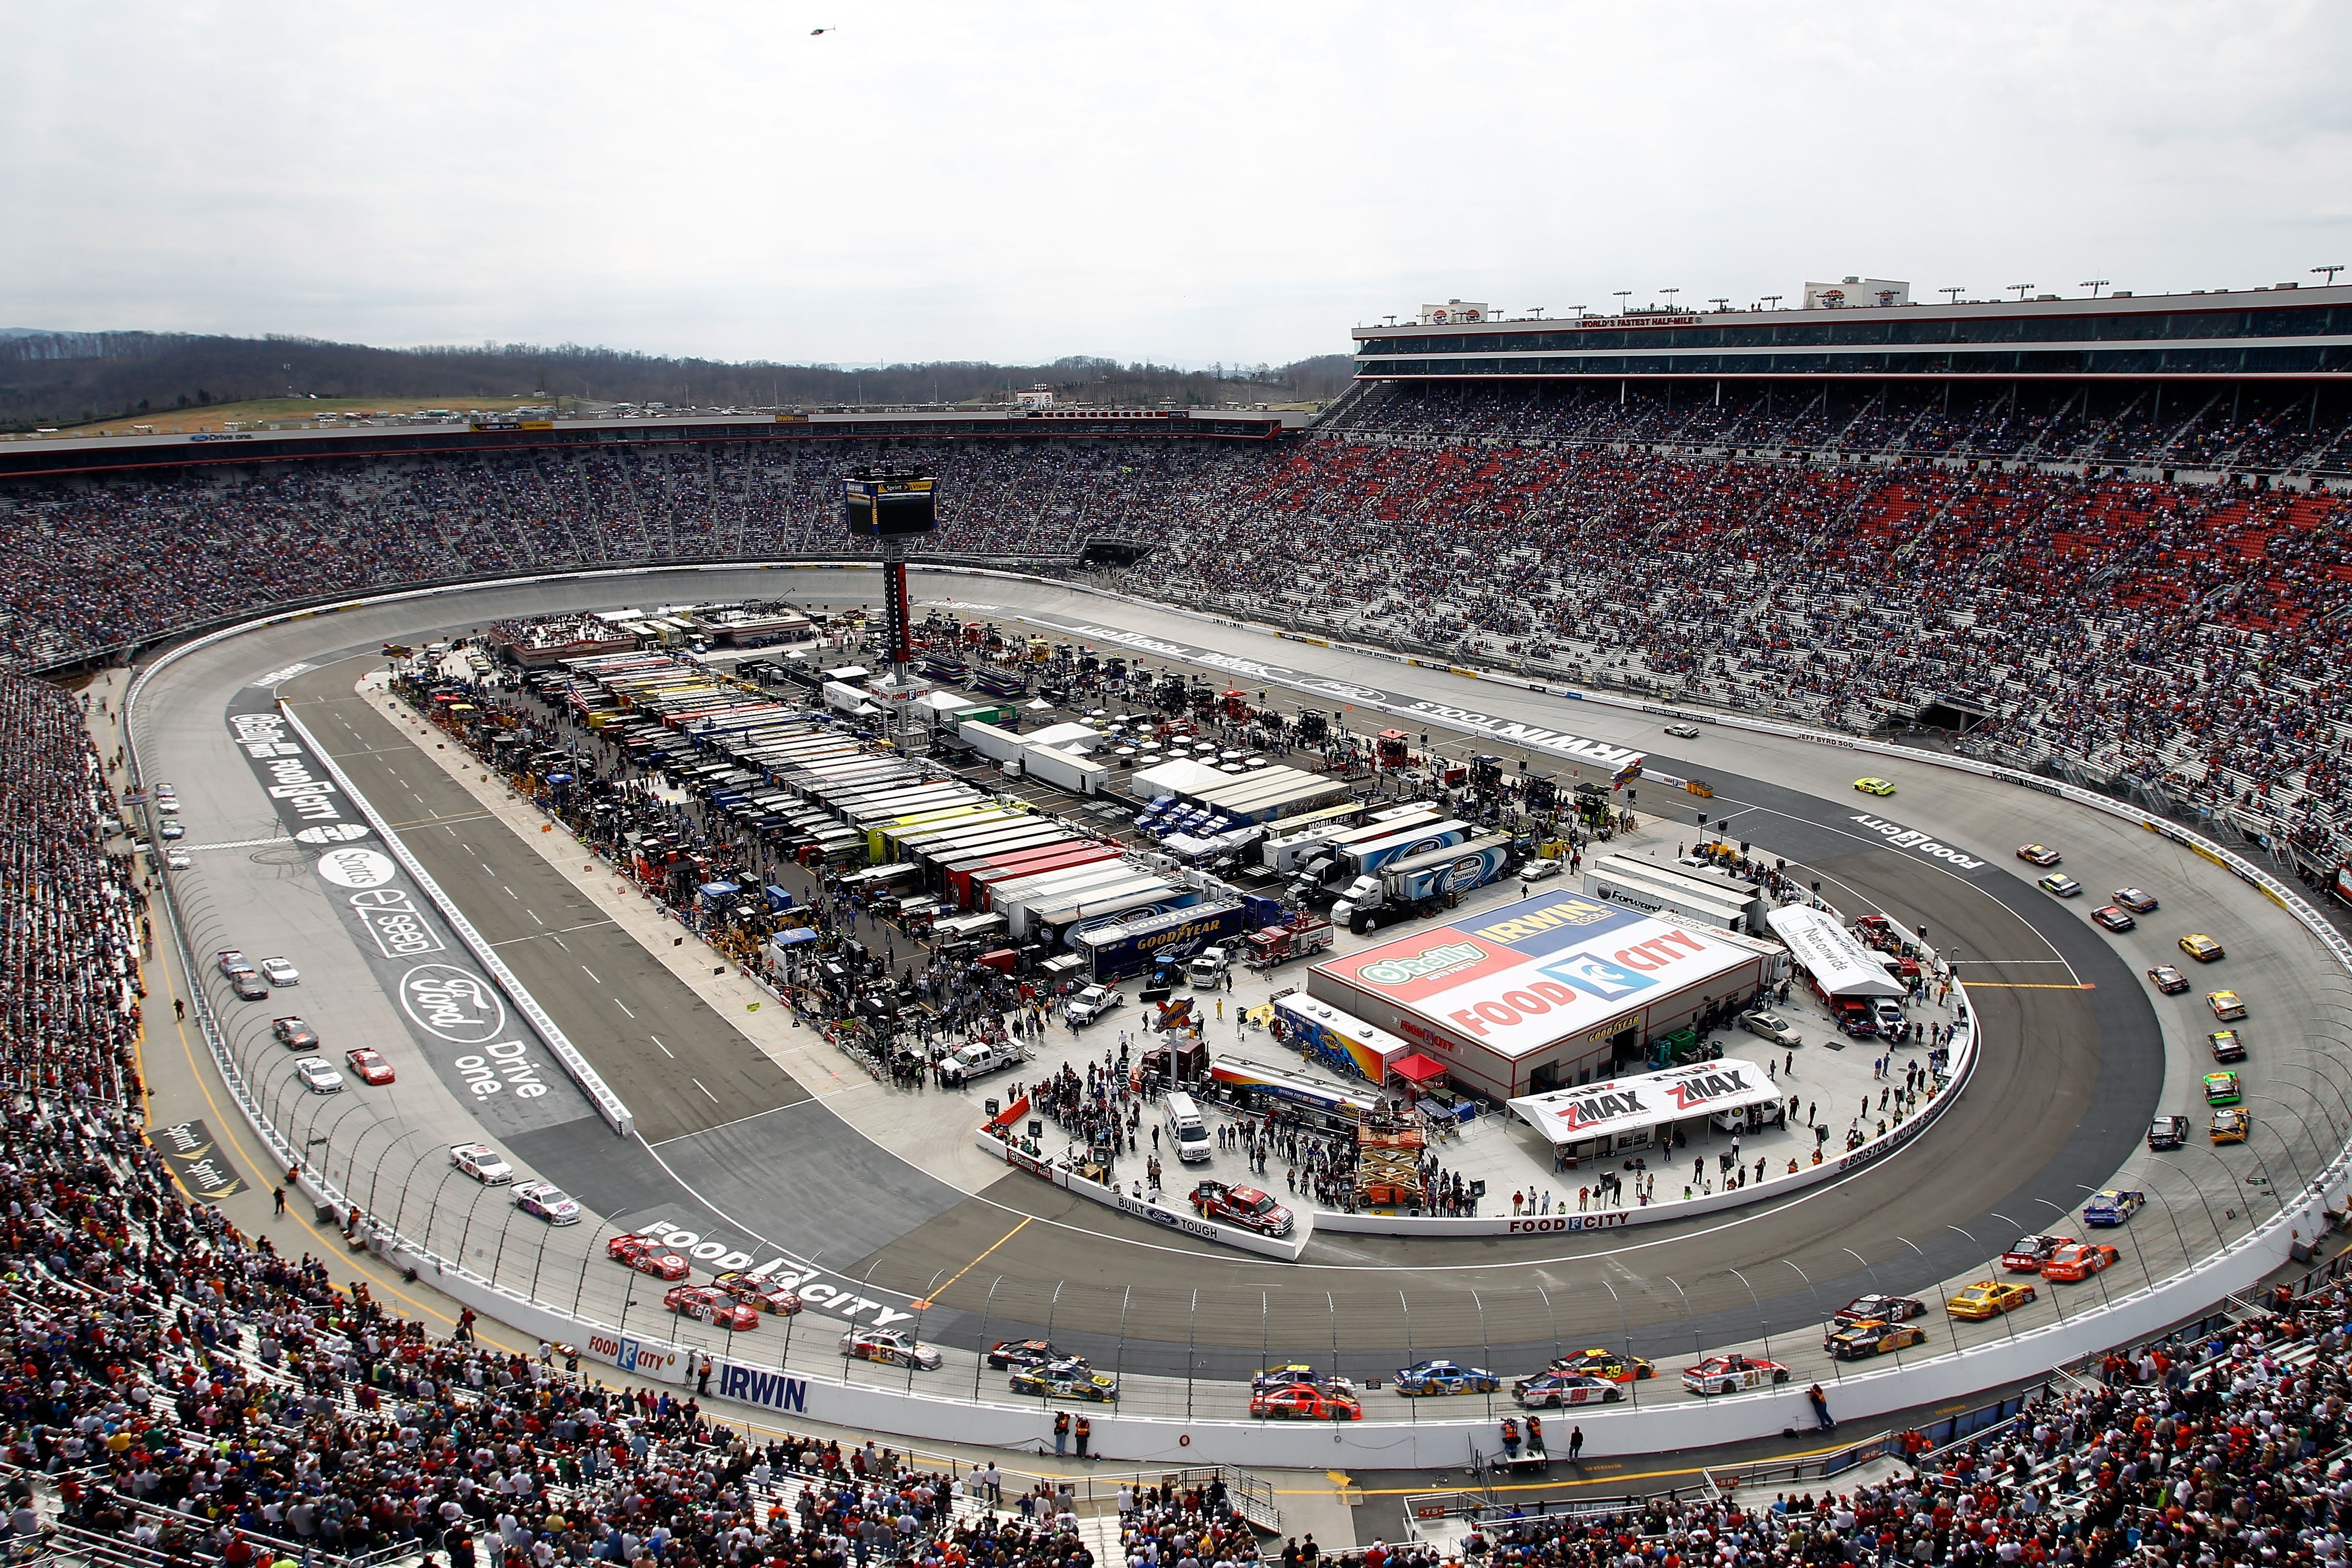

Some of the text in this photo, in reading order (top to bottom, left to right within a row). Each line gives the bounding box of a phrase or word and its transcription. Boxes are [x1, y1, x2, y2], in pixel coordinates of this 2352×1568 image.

[1581, 317, 1693, 328] WORLD'S FASTEST HALF-MILE
[1070, 625, 1191, 654] FOOD CITY
[1338, 645, 1356, 653] BRISTOL
[1373, 652, 1397, 662] SPEEDWAY
[892, 693, 907, 701] FOOD
[1644, 706, 1715, 723] sharpie.com sharpie.com
[1409, 701, 1648, 764] IRWIN TOOLS
[1496, 735, 1539, 749] Nationwide Insurance
[1797, 734, 1853, 749] JEFF BYRD 500
[1617, 768, 1642, 781] SUNOCO
[266, 758, 341, 820] FOOD CITY
[2002, 774, 2060, 796] FIRST TENNESSEE
[1308, 814, 1351, 830] MOBIL-IZE!
[1417, 843, 1435, 853] NASCAR
[1850, 814, 1985, 870] FOOD CITY
[333, 853, 378, 884] Scotts
[1459, 859, 1476, 871] NASCAR
[1611, 891, 1663, 912] Forward
[1127, 911, 1148, 921] NASCAR
[1473, 898, 1599, 944] IRWIN
[1574, 908, 1613, 926] TOOLS
[1152, 937, 1203, 957] Racing
[1710, 928, 1770, 948] FOOD CITY
[1788, 933, 1816, 961] Insurance
[1803, 928, 1849, 971] Nationwide
[1365, 941, 1485, 982] O'Reilly
[1426, 962, 1476, 982] AUTO PARTS
[1447, 930, 1706, 1036] FOOD CITY
[410, 979, 490, 1028] Ford
[1160, 999, 1194, 1030] SUNOCO
[1319, 1035, 1342, 1050] SUNOCO
[1399, 1019, 1456, 1052] FOOD CITY
[454, 1055, 502, 1101] one.
[485, 1041, 547, 1099] Drive
[1278, 1088, 1294, 1098] OFFICIAL
[1311, 1097, 1327, 1106] NASCAR
[1708, 1088, 1756, 1102] Micro-lubricant
[1335, 1103, 1366, 1116] SUNOCO
[1601, 1110, 1652, 1124] Micro-lubricant
[163, 1123, 202, 1151] Sprint
[1849, 1119, 1922, 1167] BRISTOL MOTOR
[1009, 1151, 1037, 1172] O'Reilly
[185, 1158, 228, 1189] Sprint
[1038, 1169, 1051, 1178] PARTS
[1118, 1197, 1217, 1239] BUILT Ford TOUGH
[1509, 1213, 1630, 1233] FOOD CITY
[2094, 1254, 2106, 1268] 20
[637, 1221, 914, 1326] FOOD CITY
[741, 1291, 754, 1304] 33
[2004, 1293, 2016, 1304] 22
[695, 1305, 710, 1316] 60
[1891, 1305, 1904, 1320] 29
[588, 1335, 664, 1371] FOOD CITY
[880, 1347, 895, 1361] 83
[1605, 1365, 1622, 1379] 39
[1744, 1372, 1760, 1386] 21
[721, 1364, 807, 1413] IRWIN
[1053, 1381, 1073, 1395] 43
[1447, 1378, 1465, 1392] 2
[1302, 1401, 1315, 1415] 1
